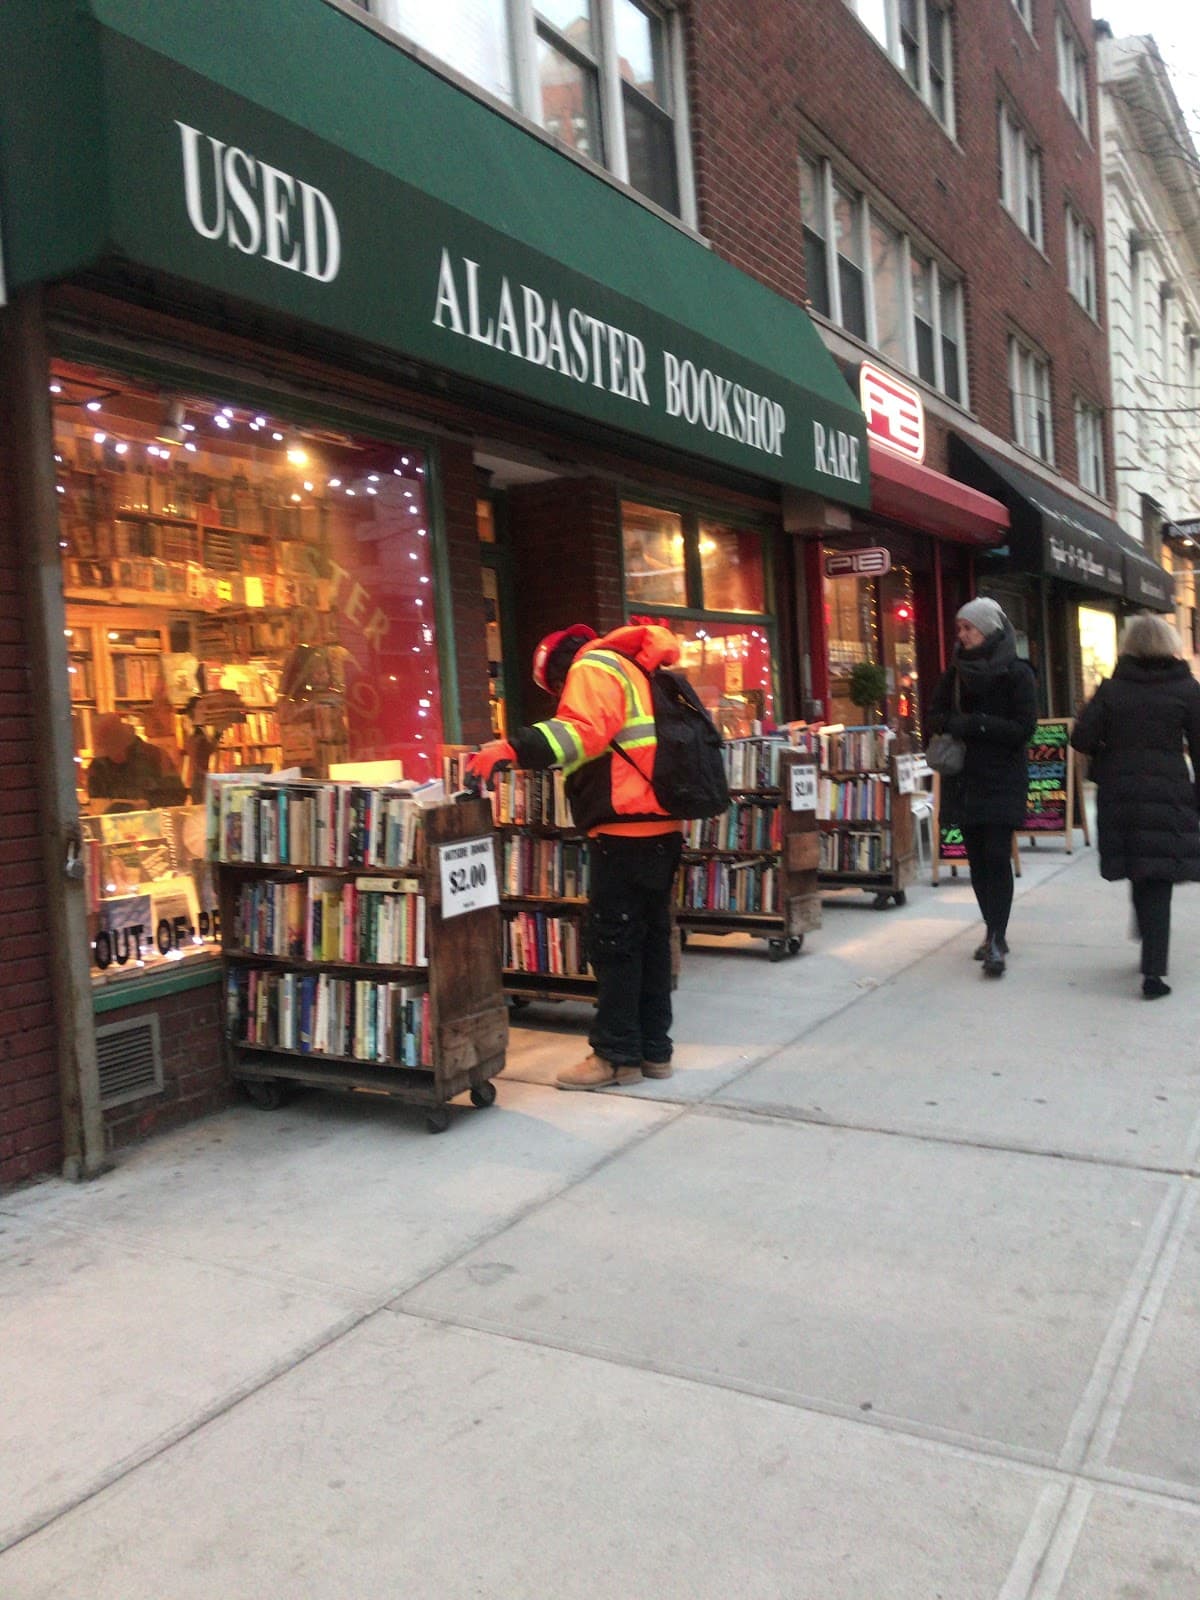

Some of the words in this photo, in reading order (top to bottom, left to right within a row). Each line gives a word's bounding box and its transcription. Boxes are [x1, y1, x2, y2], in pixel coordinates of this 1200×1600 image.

[174, 119, 341, 284] USED
[431, 246, 651, 406] ALABASTER
[663, 350, 786, 457] BOOKSHOP
[812, 420, 862, 485] RARE
[827, 553, 883, 574] PIE
[448, 863, 487, 896] $2.00
